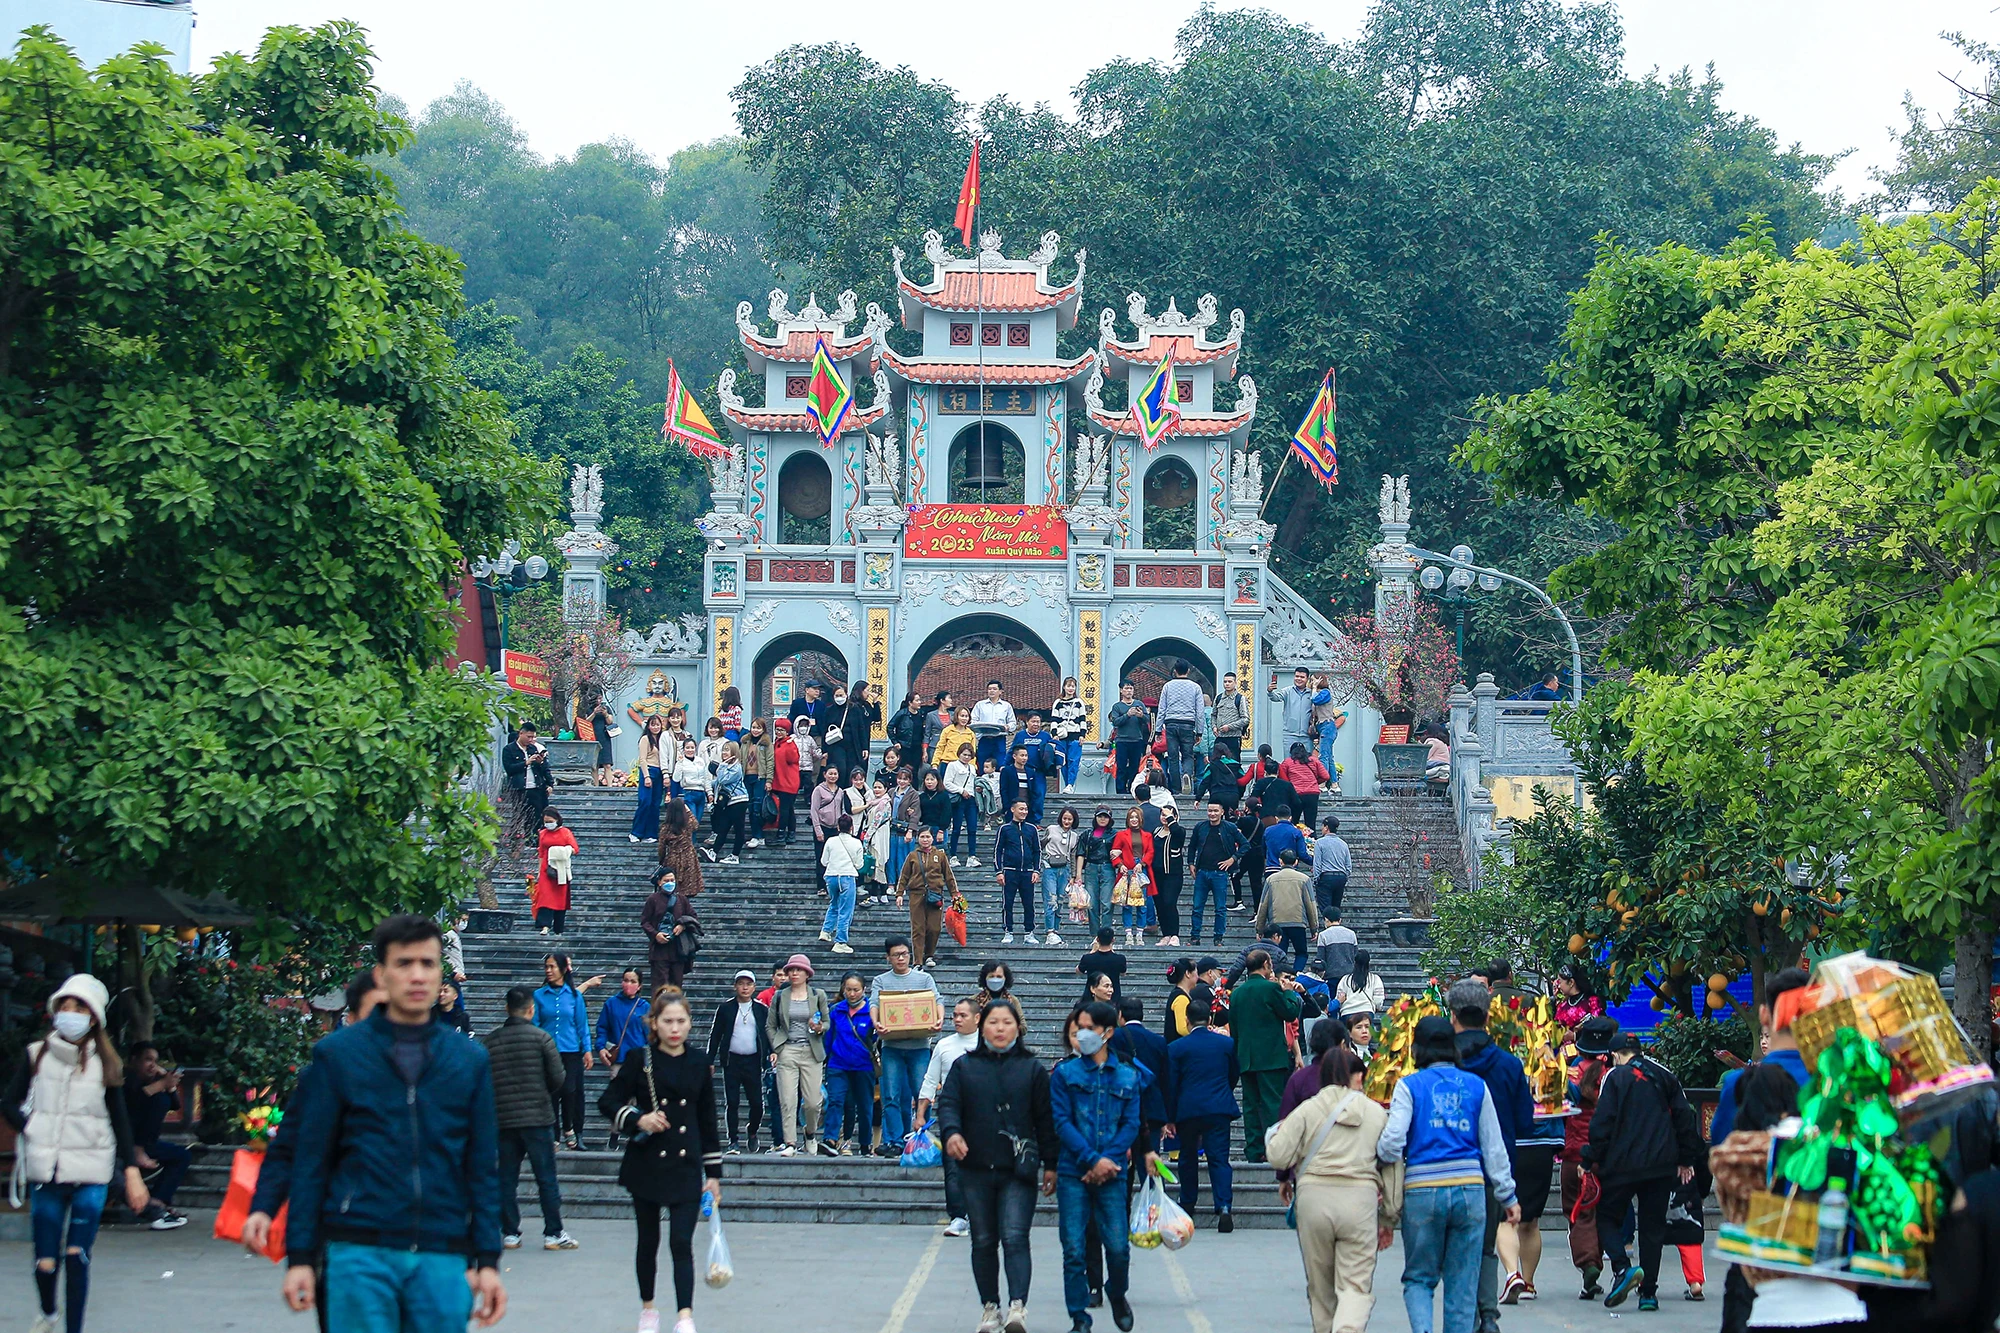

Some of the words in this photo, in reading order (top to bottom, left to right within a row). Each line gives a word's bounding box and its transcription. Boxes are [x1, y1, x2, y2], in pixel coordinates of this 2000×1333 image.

[931, 535, 975, 553] 2023
[976, 525, 1015, 545] Năm
[985, 546, 1006, 555] Xuân
[1007, 546, 1023, 557] Quý
[1024, 547, 1043, 556] Mão
